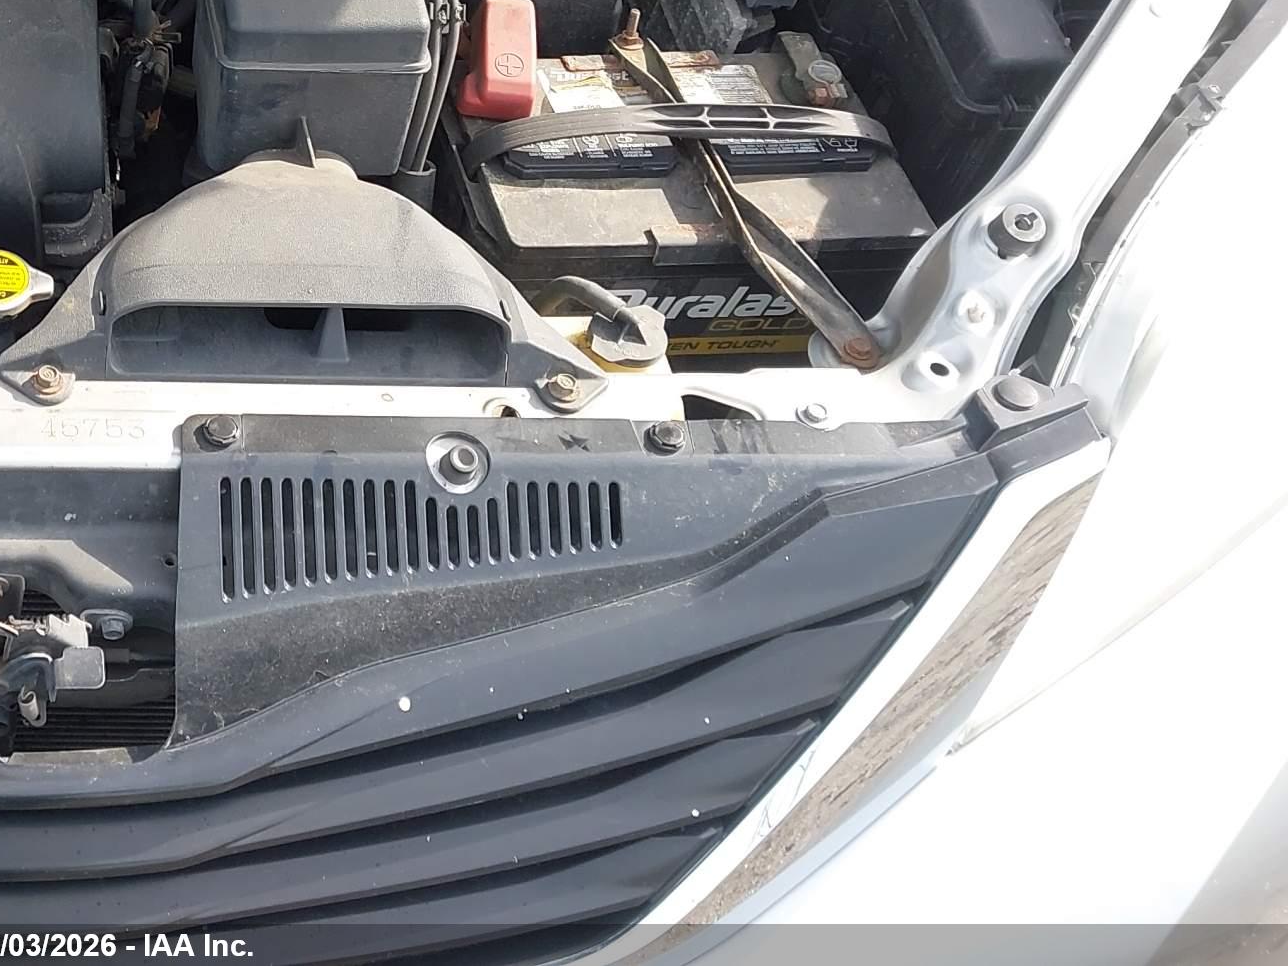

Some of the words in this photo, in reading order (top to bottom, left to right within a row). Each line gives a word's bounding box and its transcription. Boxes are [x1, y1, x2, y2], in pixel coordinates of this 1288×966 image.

[607, 285, 796, 320] Duralas
[708, 318, 810, 332] GOLD
[707, 339, 777, 350] TOUGH
[40, 417, 145, 439] 45753
